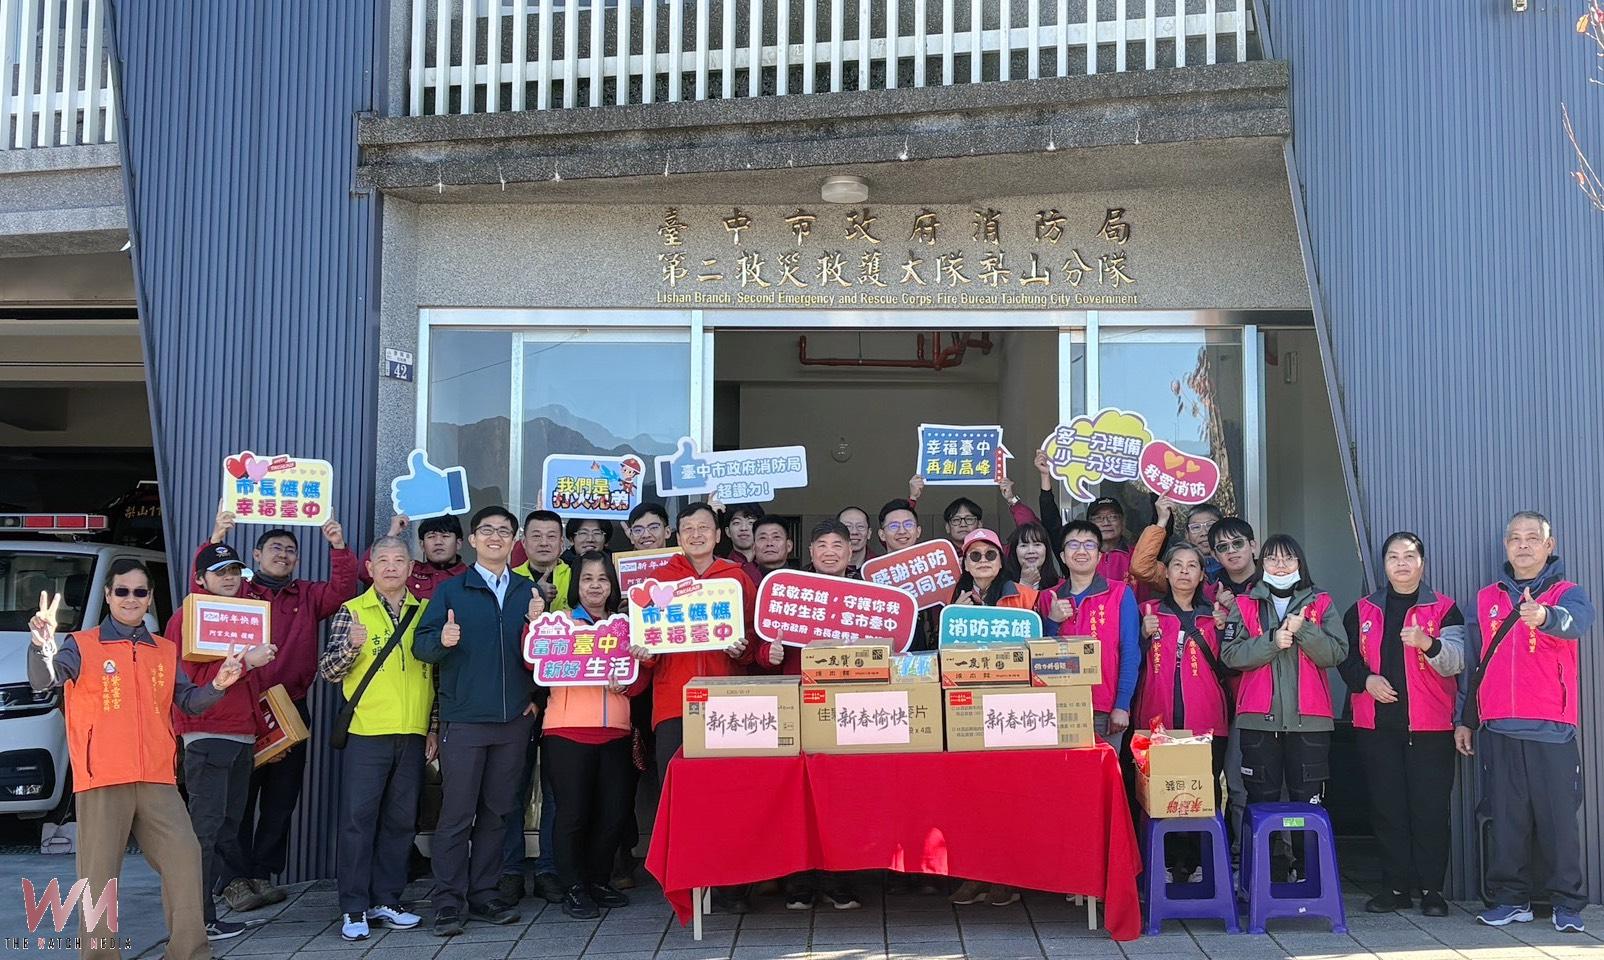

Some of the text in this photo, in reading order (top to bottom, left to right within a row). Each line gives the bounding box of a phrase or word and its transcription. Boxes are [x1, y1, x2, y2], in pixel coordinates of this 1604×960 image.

[657, 207, 1131, 246] 臺中市政府消防局
[657, 249, 1137, 288] 第二救災救護大隊梨山分隊
[656, 292, 692, 304] Lishan
[737, 292, 775, 304] Second
[778, 292, 835, 307] Emergency
[838, 292, 857, 304] and
[860, 292, 898, 304] Rescue
[937, 292, 958, 304] Fire
[1001, 292, 1047, 306] Taichung
[1050, 292, 1072, 306] City
[1075, 292, 1138, 305] Government
[393, 363, 407, 379] 42
[927, 439, 991, 456] 幸福臺中
[1058, 427, 1142, 456] 多一分準備
[681, 457, 801, 480] 臺中市政府消防局
[927, 458, 991, 475] 再創高峰
[1054, 448, 1138, 477] 少一分災害
[236, 479, 320, 499] 市長媽媽
[557, 476, 610, 495] 我們是
[1144, 463, 1206, 497] 我愛消防
[236, 498, 320, 518] 幸福臺中
[552, 489, 630, 510] 打火兄弟
[871, 549, 948, 585] 感謝消防
[219, 613, 259, 626] 新年快樂
[641, 601, 731, 624] 市長媽媽
[644, 622, 733, 646] 幸福臺中
[762, 618, 808, 634] 臺中市政府
[948, 617, 1032, 639] 消防英雄
[532, 633, 618, 656] 富市臺中
[543, 656, 631, 679] 新好生活
[706, 710, 777, 737] 新春愉快
[837, 706, 909, 734] 新春愉快
[984, 708, 1057, 736] 新春愉快
